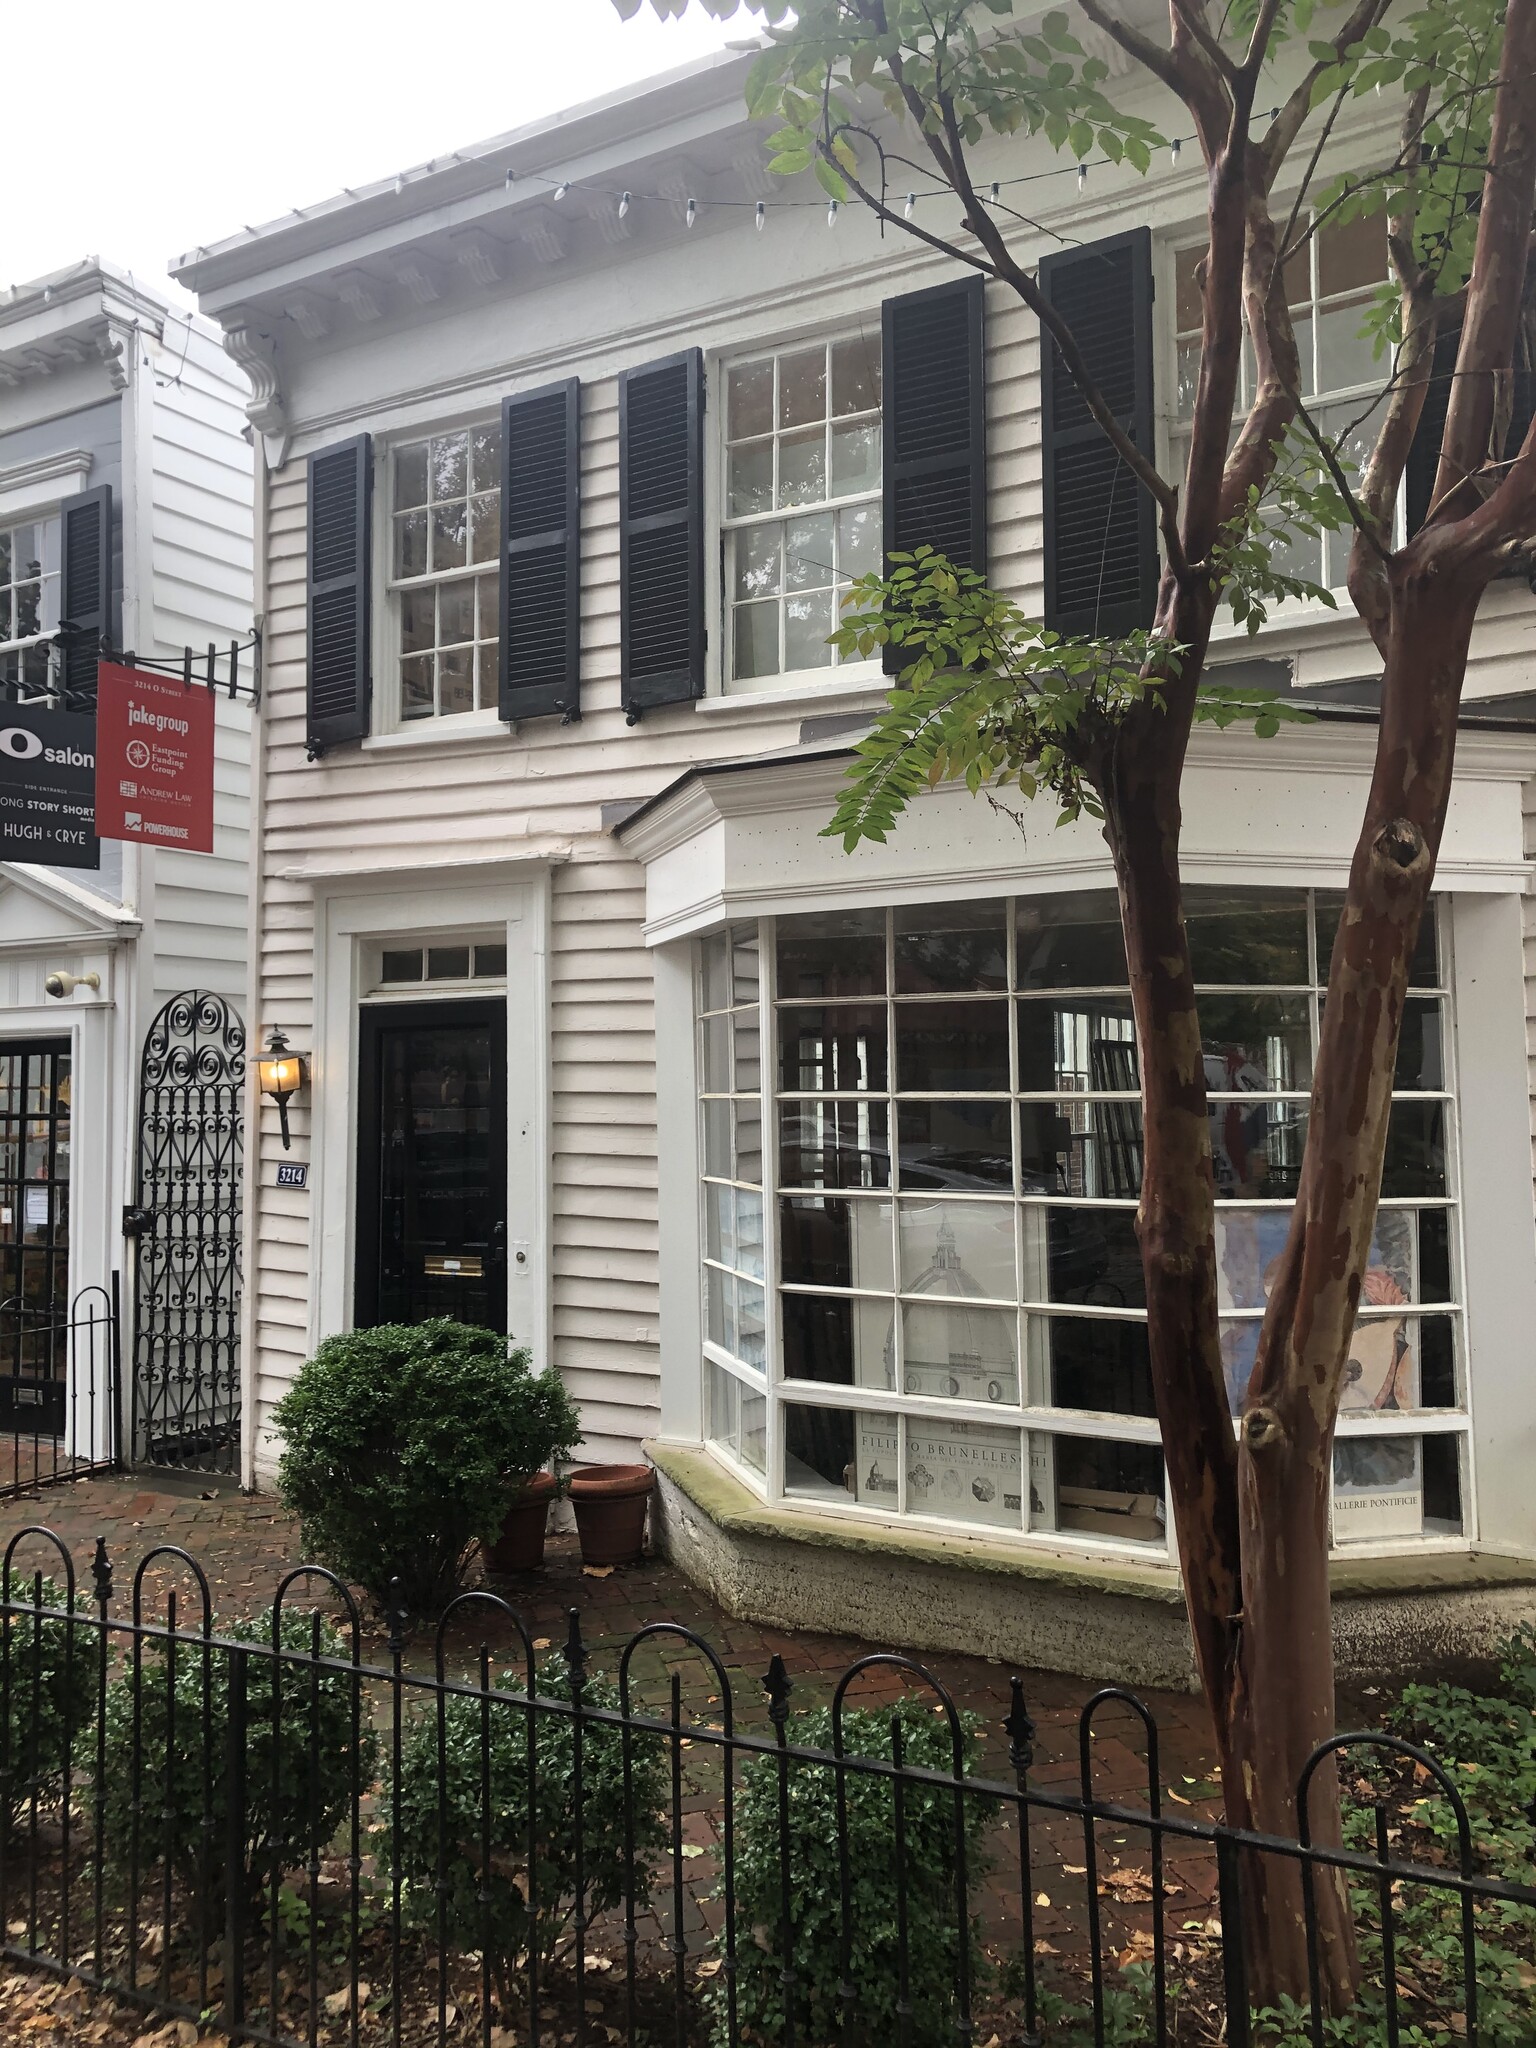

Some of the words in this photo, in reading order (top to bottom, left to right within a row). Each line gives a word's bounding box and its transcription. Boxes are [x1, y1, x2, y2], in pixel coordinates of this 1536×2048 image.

[134, 680, 152, 691] 3214
[152, 684, 160, 692] O
[44, 746, 95, 769] salon
[152, 743, 188, 759] Eastpoint
[151, 756, 185, 770] Funding
[151, 763, 177, 777] Group
[39, 786, 68, 795] ENTRANCE
[139, 785, 174, 799] ANDREW
[0, 796, 24, 808] ONG
[27, 799, 60, 813] STORY
[62, 804, 95, 817] SHORT
[4, 822, 43, 841] HUGH
[46, 829, 52, 838] &
[55, 828, 86, 846] CRYE
[143, 822, 189, 839] POWERHOUSE
[279, 1167, 303, 1183] 3214
[862, 1436, 920, 1453] FILIPO
[928, 1444, 1047, 1468] BRUNELLESHI
[1334, 1500, 1367, 1510] ALLERIE
[1370, 1496, 1418, 1508] PONTIFICIE
